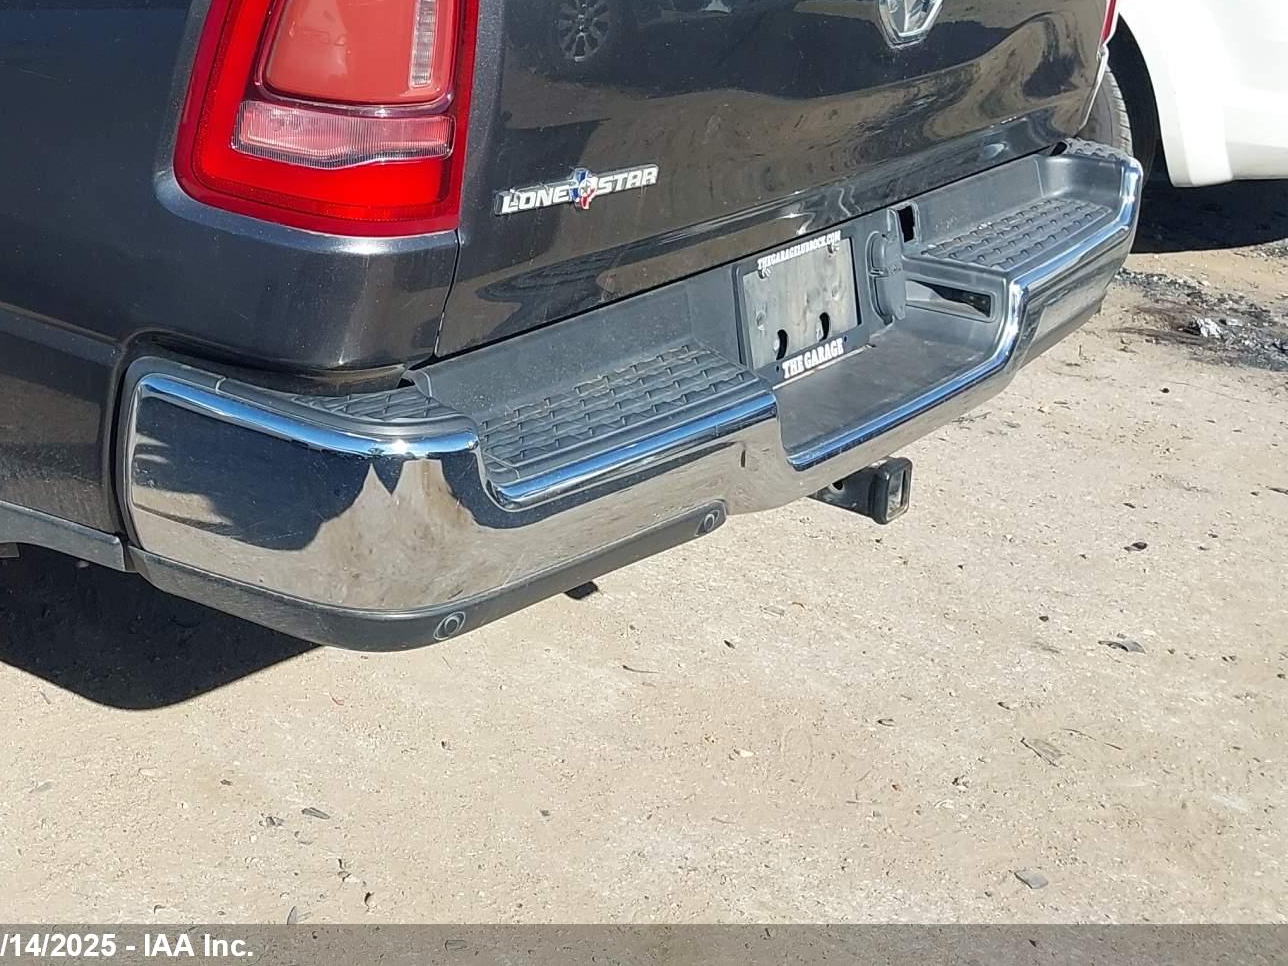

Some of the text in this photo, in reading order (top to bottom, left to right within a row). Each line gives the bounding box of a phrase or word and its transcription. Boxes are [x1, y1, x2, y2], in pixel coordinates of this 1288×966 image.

[500, 165, 659, 214] LONE STAR
[782, 337, 844, 379] THE GARAGE
